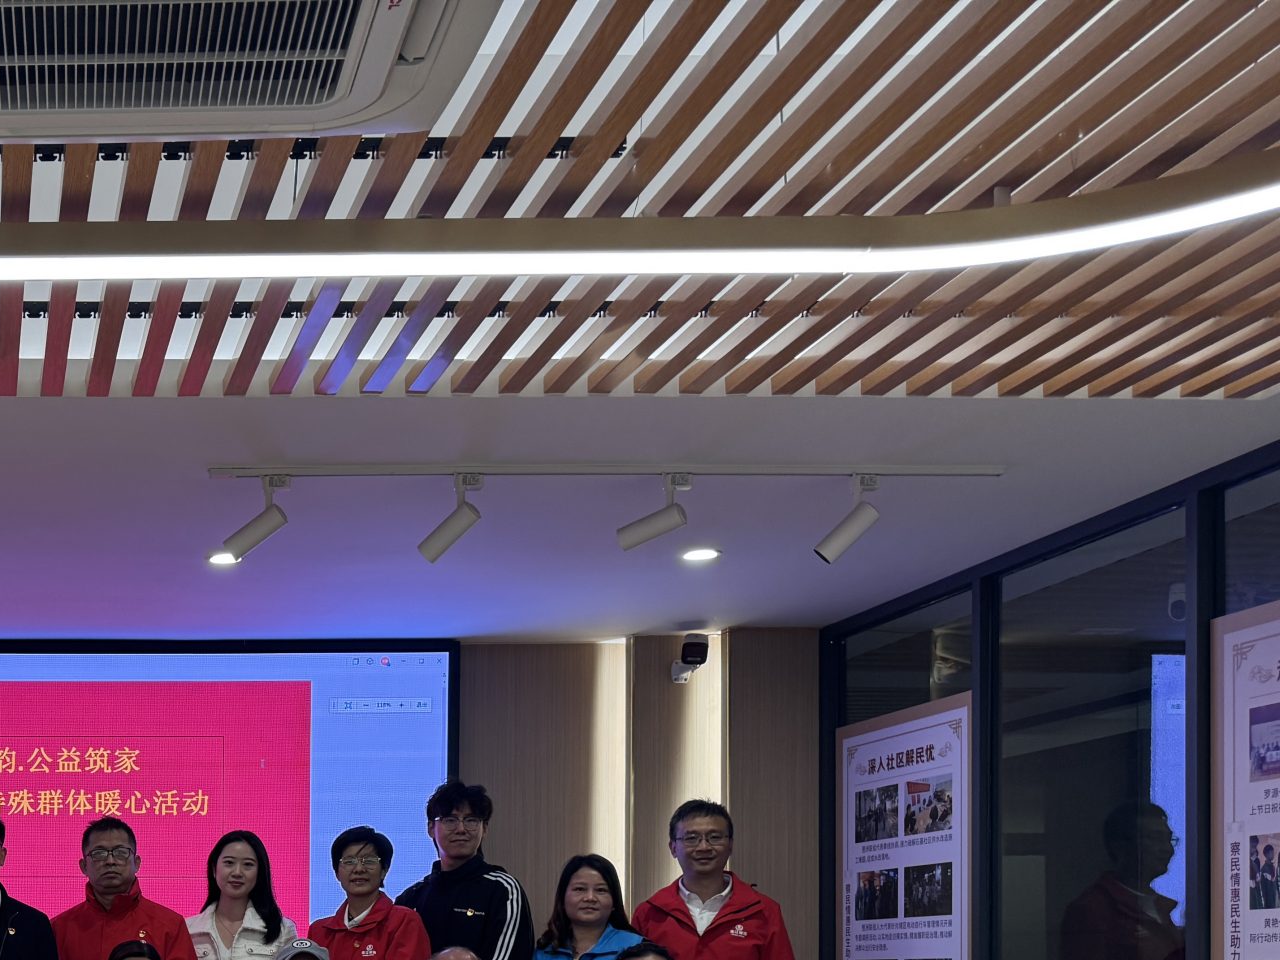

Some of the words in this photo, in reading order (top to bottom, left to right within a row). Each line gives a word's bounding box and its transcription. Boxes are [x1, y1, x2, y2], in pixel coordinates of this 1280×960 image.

[867, 744, 935, 775] 深入社区解民忧
[1264, 788, 1280, 801] 罗源
[1264, 917, 1280, 930] 黄艳
[1249, 932, 1280, 944] 际行动传
